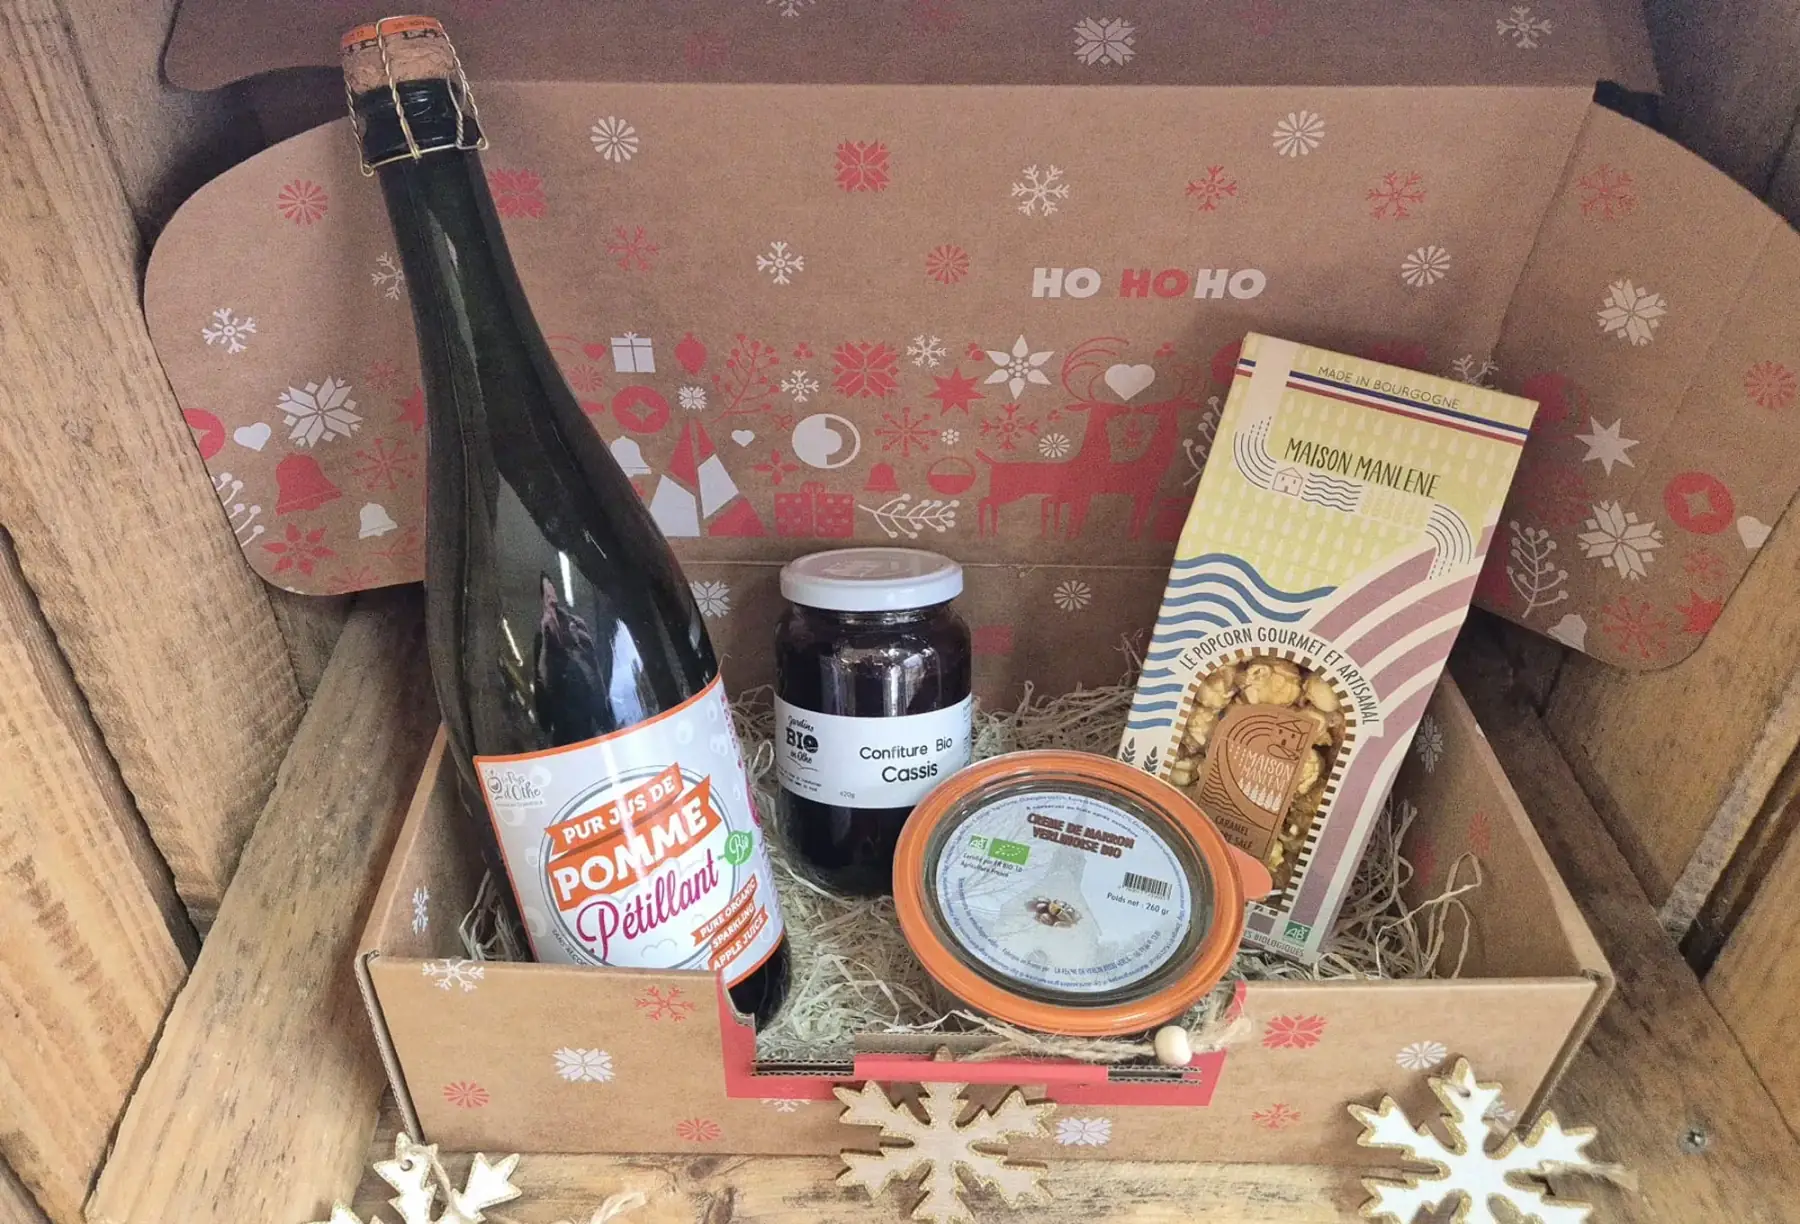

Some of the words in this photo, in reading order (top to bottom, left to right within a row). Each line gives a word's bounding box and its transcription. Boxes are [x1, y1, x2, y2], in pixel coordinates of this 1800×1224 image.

[1032, 267, 1101, 298] HO
[1119, 268, 1189, 298] HO
[1193, 268, 1267, 299] HO
[1317, 365, 1351, 384] MADE
[1356, 374, 1371, 388] IN
[1374, 379, 1461, 410] BOURGOGNE
[1284, 437, 1351, 475] MAISON
[1354, 455, 1442, 499] MANLENE
[1179, 655, 1198, 671] LE
[1193, 627, 1253, 661] POPCORN
[1257, 626, 1326, 656] GOURMET
[1323, 649, 1344, 667] ET
[1336, 663, 1380, 725] ARTISANAL
[785, 727, 819, 754] BIO
[859, 745, 929, 760] Confiture
[935, 736, 953, 752] Bio
[882, 760, 938, 783] Cassis
[1245, 748, 1294, 780] MAISON
[562, 816, 606, 846] PUR
[608, 793, 647, 826] JUS
[651, 774, 676, 804] DE
[1215, 814, 1249, 836] CARAMEL
[553, 797, 709, 902] POMME
[1065, 821, 1083, 836] DE
[1084, 827, 1135, 849] MARRON
[576, 848, 719, 966] Pétillant
[700, 913, 724, 938] PURE
[725, 880, 756, 916] ORGANIC
[1107, 891, 1126, 905] Poids
[1127, 899, 1140, 908] net
[1145, 902, 1160, 913] 260
[1160, 908, 1169, 916] gr
[712, 903, 755, 949] SPARKLING
[714, 941, 743, 970] APPLE
[741, 914, 764, 943] JUICE
[1283, 923, 1310, 941] AB
[1254, 932, 1305, 957] BIOLOGIQUES
